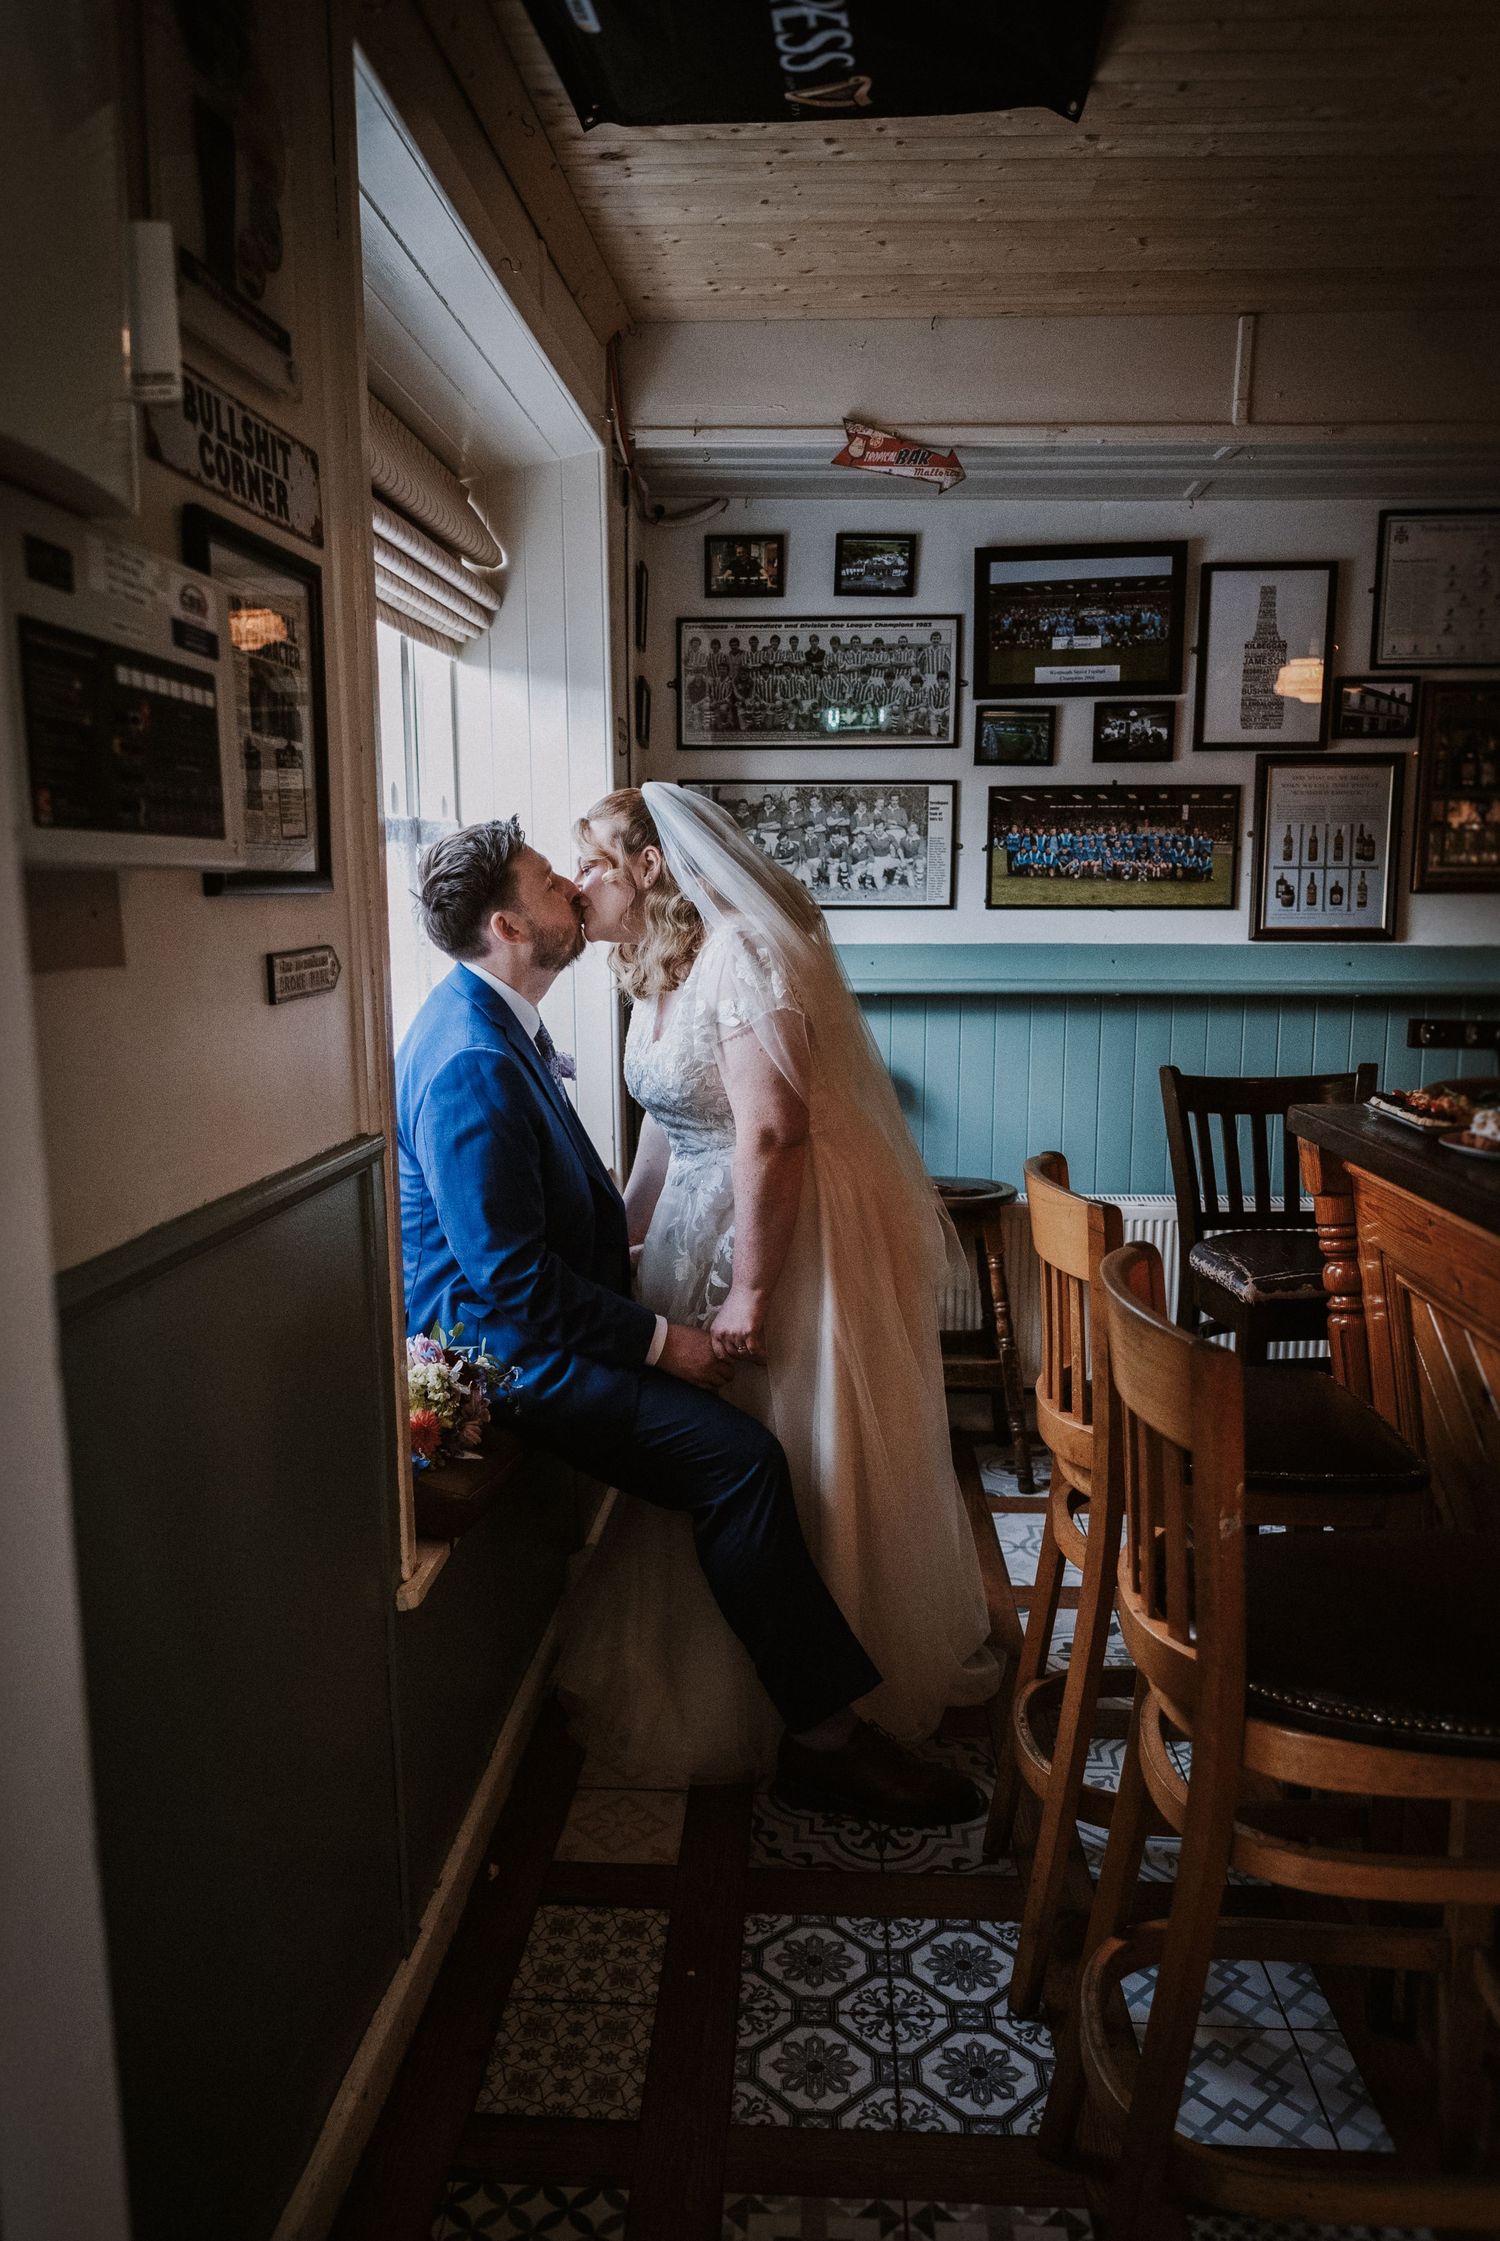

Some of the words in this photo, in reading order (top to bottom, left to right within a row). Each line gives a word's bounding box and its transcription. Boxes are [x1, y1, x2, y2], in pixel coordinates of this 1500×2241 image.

[182, 375, 292, 480] BULLSHIT
[198, 433, 291, 521] CORNER
[864, 451, 896, 463] TROPICAL
[895, 448, 930, 465] BAR
[914, 467, 960, 477] Mallorca
